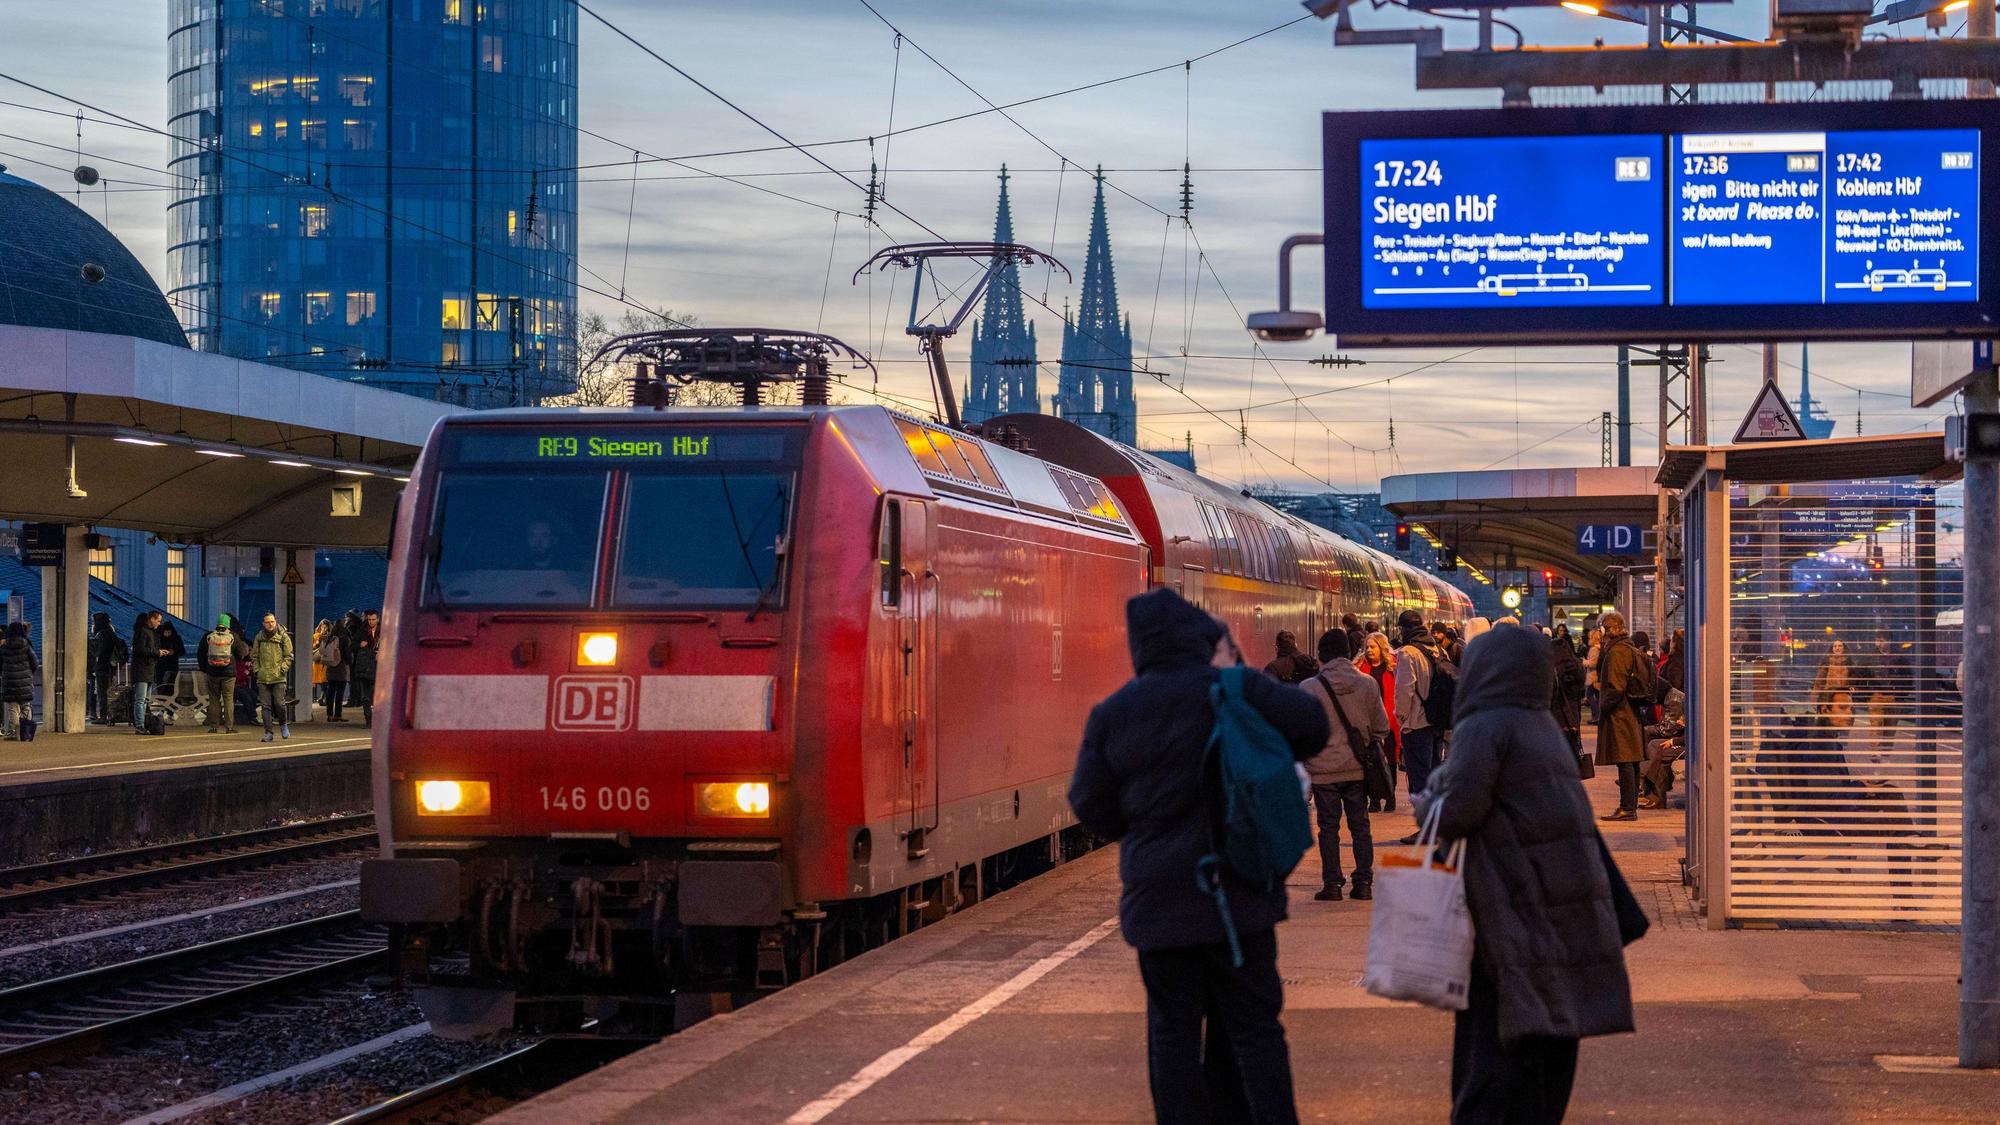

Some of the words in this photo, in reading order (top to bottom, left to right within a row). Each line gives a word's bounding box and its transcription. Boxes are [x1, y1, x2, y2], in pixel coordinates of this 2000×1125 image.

[1683, 156, 1729, 175] 17:36
[1836, 152, 1882, 172] 17:42
[1373, 159, 1443, 187] 17:24
[1725, 179, 1760, 198] Bitte
[1762, 178, 1798, 198] nicht
[1836, 177, 1893, 197] Koblenz
[1895, 176, 1922, 196] Hbf
[1373, 195, 1450, 230] Siegen
[1455, 193, 1498, 222] Hbf
[1697, 202, 1740, 222] board
[1746, 202, 1794, 220] Please
[1909, 208, 1952, 222] Troisdorf
[1890, 222, 1944, 238] Linz(Rhein)
[538, 437, 578, 456] RE9
[588, 437, 662, 456] Siegen
[672, 436, 710, 456] Hbf
[1580, 525, 1596, 548] 4
[1614, 525, 1632, 548] D
[562, 683, 624, 723] DB
[540, 786, 587, 811] 146
[598, 786, 650, 811] 006
